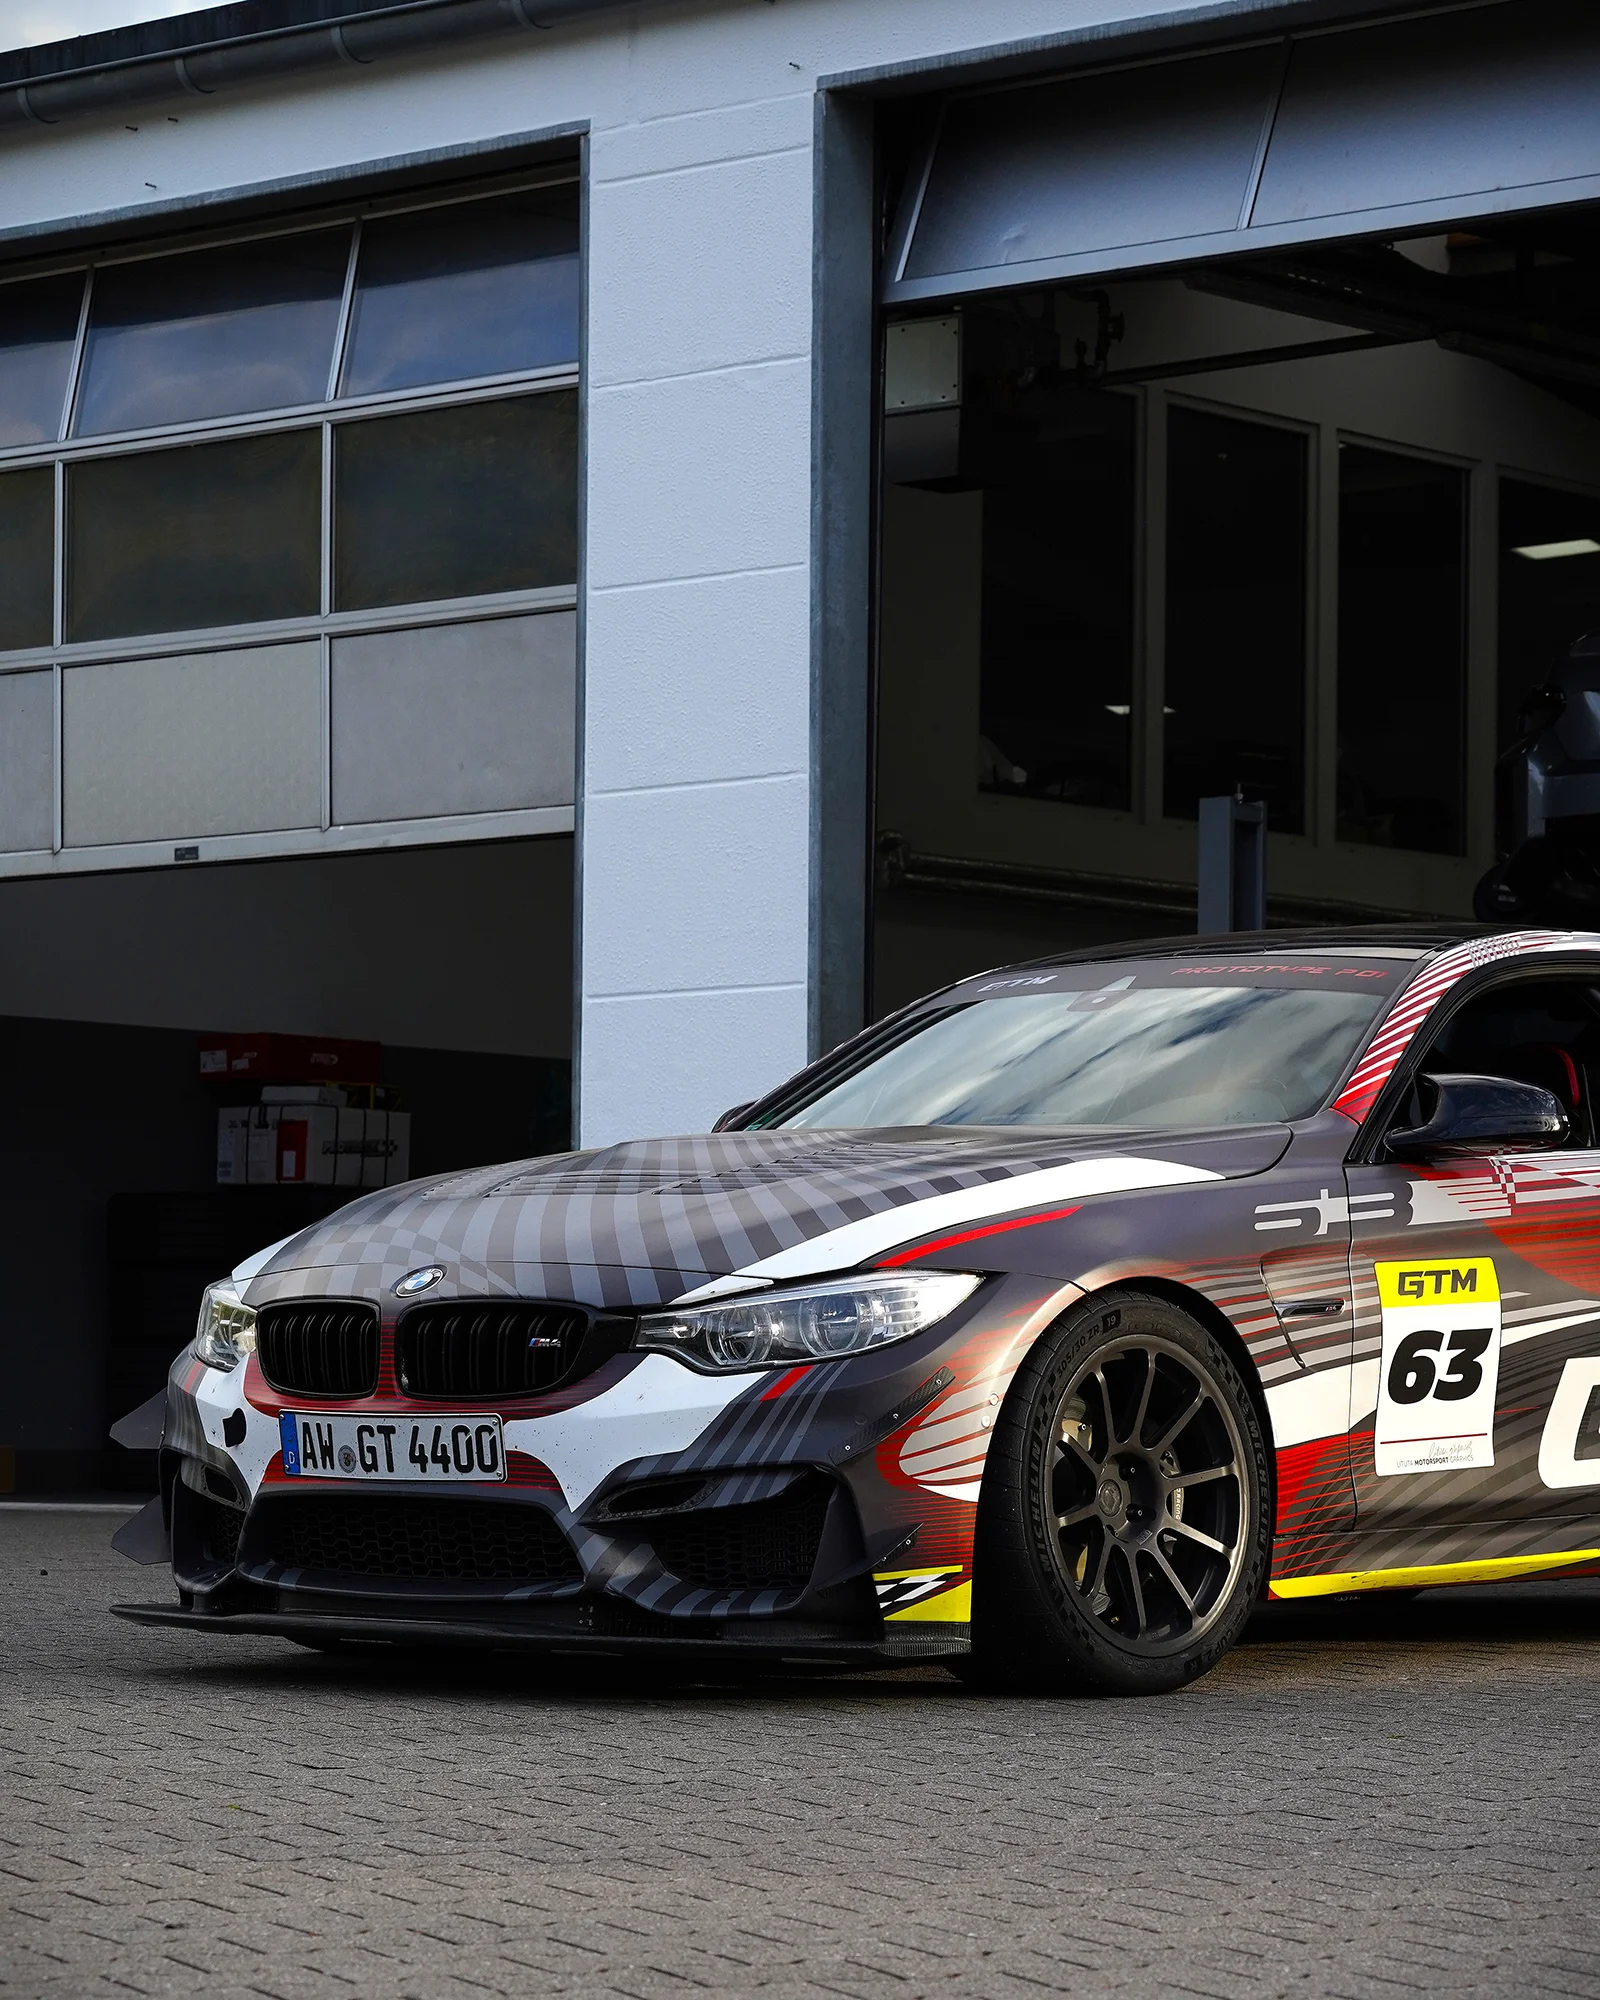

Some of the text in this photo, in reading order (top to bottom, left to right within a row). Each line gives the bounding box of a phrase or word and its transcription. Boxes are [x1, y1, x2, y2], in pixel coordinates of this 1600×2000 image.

[977, 975, 1058, 992] GTM
[1171, 965, 1331, 976] PROTOTYPE
[1398, 1268, 1477, 1299] GTM
[1056, 1314, 1116, 1379] 305/30 ZR 19
[1388, 1328, 1493, 1404] 63
[302, 1421, 335, 1470] AW
[357, 1424, 396, 1473] GT
[408, 1424, 499, 1473] 4400
[1414, 1457, 1449, 1467] MOTORSPORT
[1248, 1420, 1268, 1546] MICHELIN
[1029, 1440, 1052, 1572] MICHELIN
[1215, 1629, 1233, 1654] CUP
